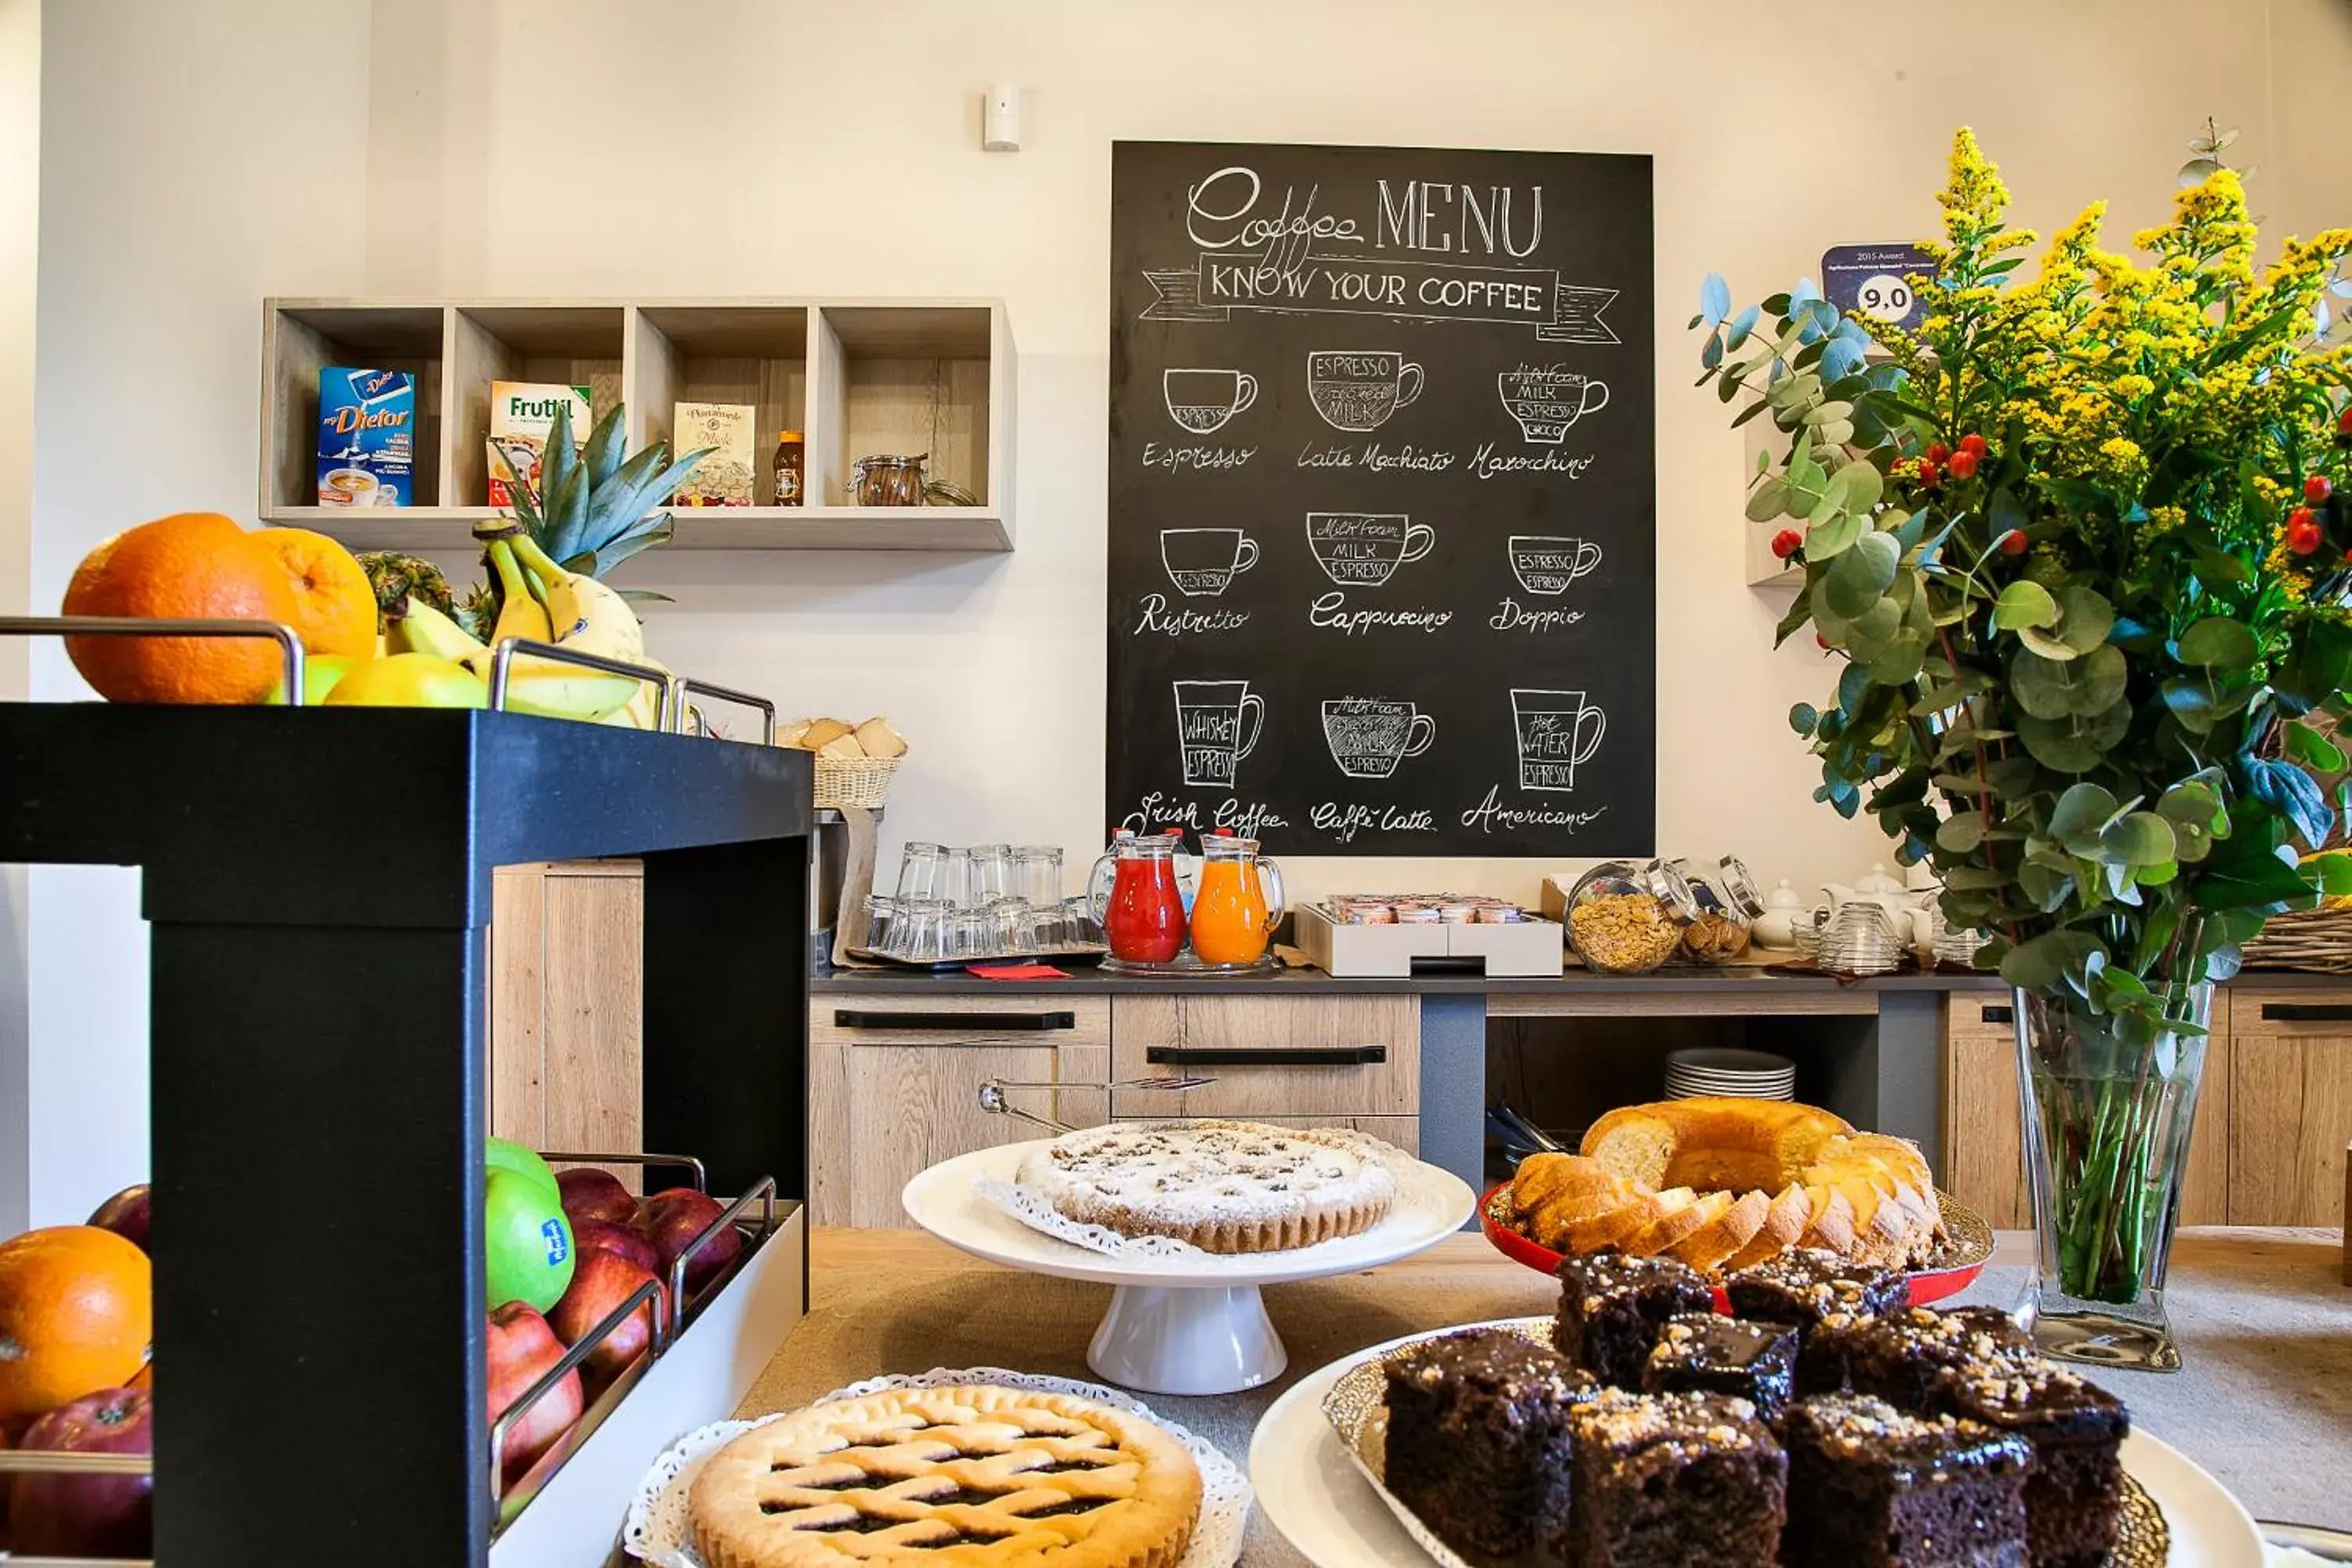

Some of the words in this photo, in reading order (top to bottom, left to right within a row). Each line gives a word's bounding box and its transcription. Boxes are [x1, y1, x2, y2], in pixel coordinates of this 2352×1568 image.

[1187, 167, 1364, 279] Coffee
[1375, 180, 1542, 257] MENU
[1210, 264, 1318, 298] KNOW
[1324, 270, 1406, 305] YOUR
[1418, 278, 1542, 311] COFFEE
[1316, 358, 1390, 376] ESPRESSO
[1517, 385, 1555, 400] MILK
[335, 406, 409, 434] Dietor
[1178, 408, 1229, 428] ESPRESSO
[1327, 401, 1375, 422] MILK
[1518, 403, 1576, 419] ESPRESSO
[1142, 441, 1258, 474] Espresso
[1298, 440, 1354, 467] Latte
[1359, 443, 1456, 471] Macchiato
[1333, 543, 1377, 559] MILK
[1518, 554, 1573, 570] ESPRESSO
[1332, 562, 1388, 578] ESPRESSO
[1526, 575, 1566, 589] ESPRESSO
[1134, 593, 1250, 636] Ristretto
[1310, 592, 1452, 633] Cappuccino
[1490, 597, 1585, 633] Doppio
[1184, 710, 1237, 742] WHISKEY
[1521, 731, 1570, 757] WATER
[1188, 750, 1236, 778] ESPRESSO
[1345, 757, 1391, 772] ESPRESSO
[1524, 764, 1569, 786] ESPRESSO
[1122, 792, 1203, 837] Irish
[1213, 798, 1288, 839] Coffee
[1461, 784, 1608, 834] Americano
